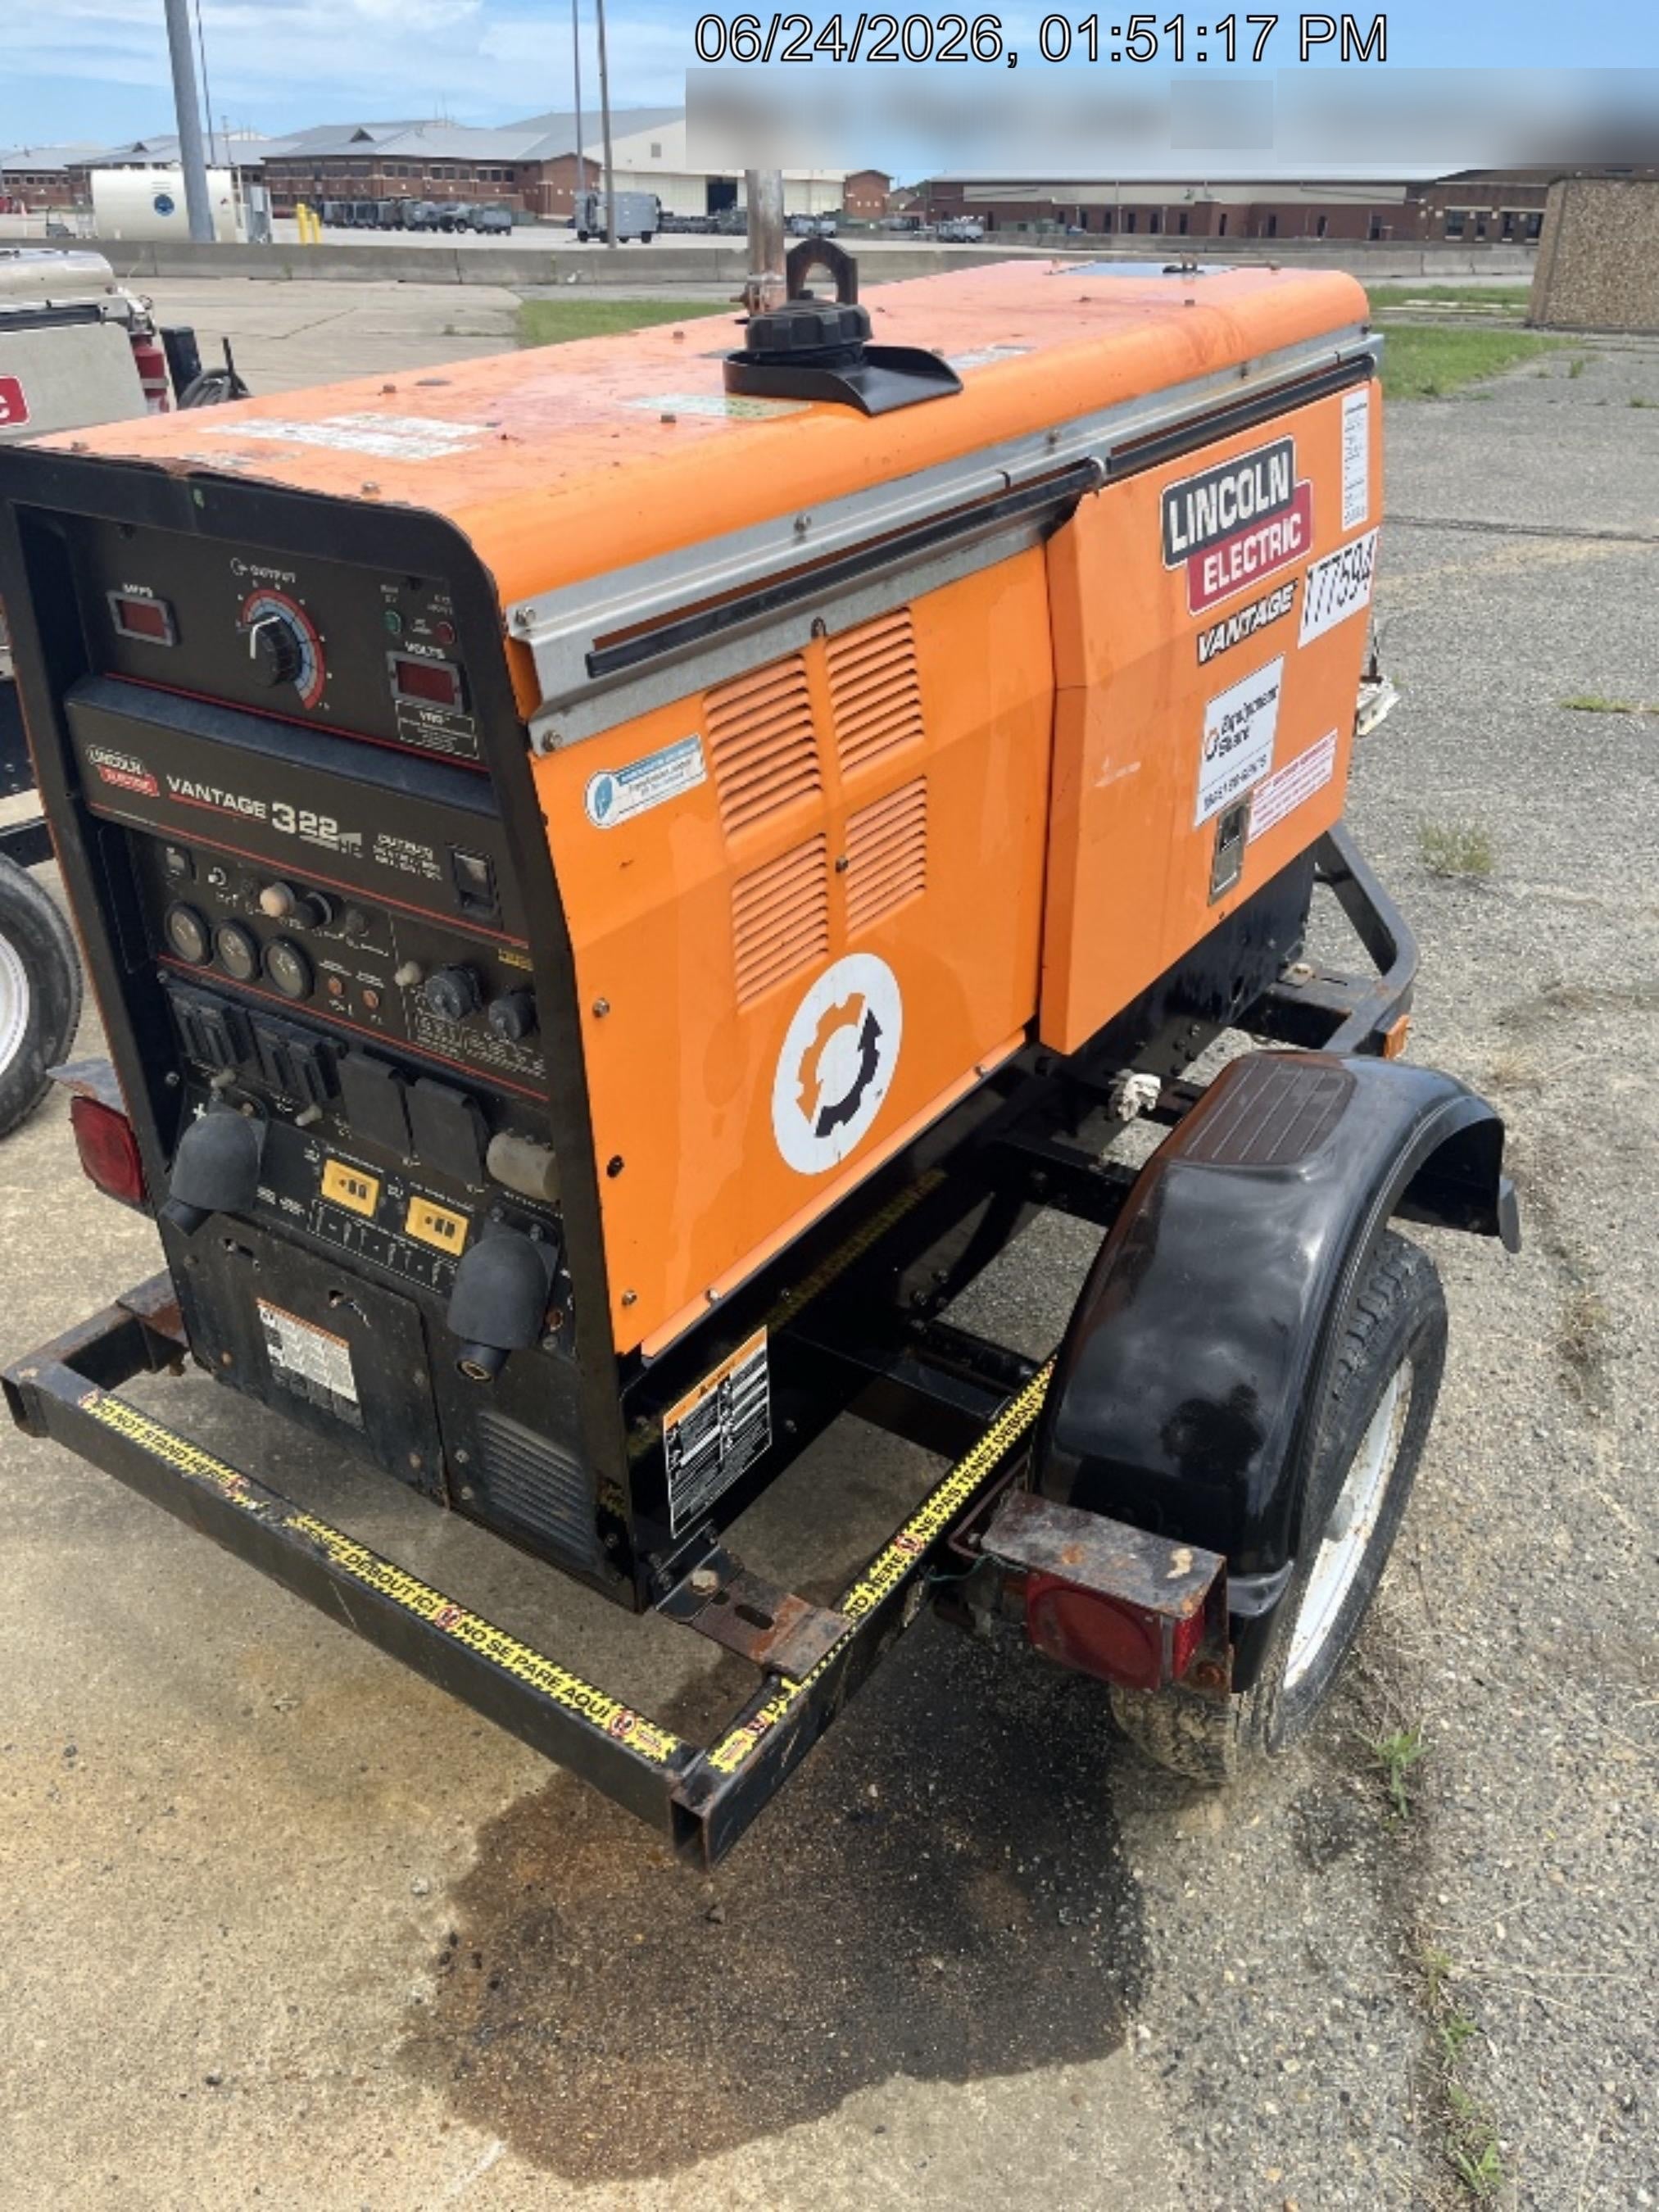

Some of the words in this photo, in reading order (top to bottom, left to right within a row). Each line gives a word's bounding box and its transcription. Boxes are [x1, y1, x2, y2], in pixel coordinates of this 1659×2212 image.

[1169, 451, 1290, 554] LINCOLN
[1203, 513, 1302, 596] ELECTRIC
[1198, 580, 1296, 665] VANTAGE
[166, 773, 267, 819] VANTAGE
[272, 801, 338, 842] 322
[344, 1551, 416, 1597] DEBOUT
[412, 1593, 439, 1614] ICI
[458, 1620, 487, 1643] NO
[486, 1639, 514, 1660] SE
[510, 1653, 564, 1689] PARE
